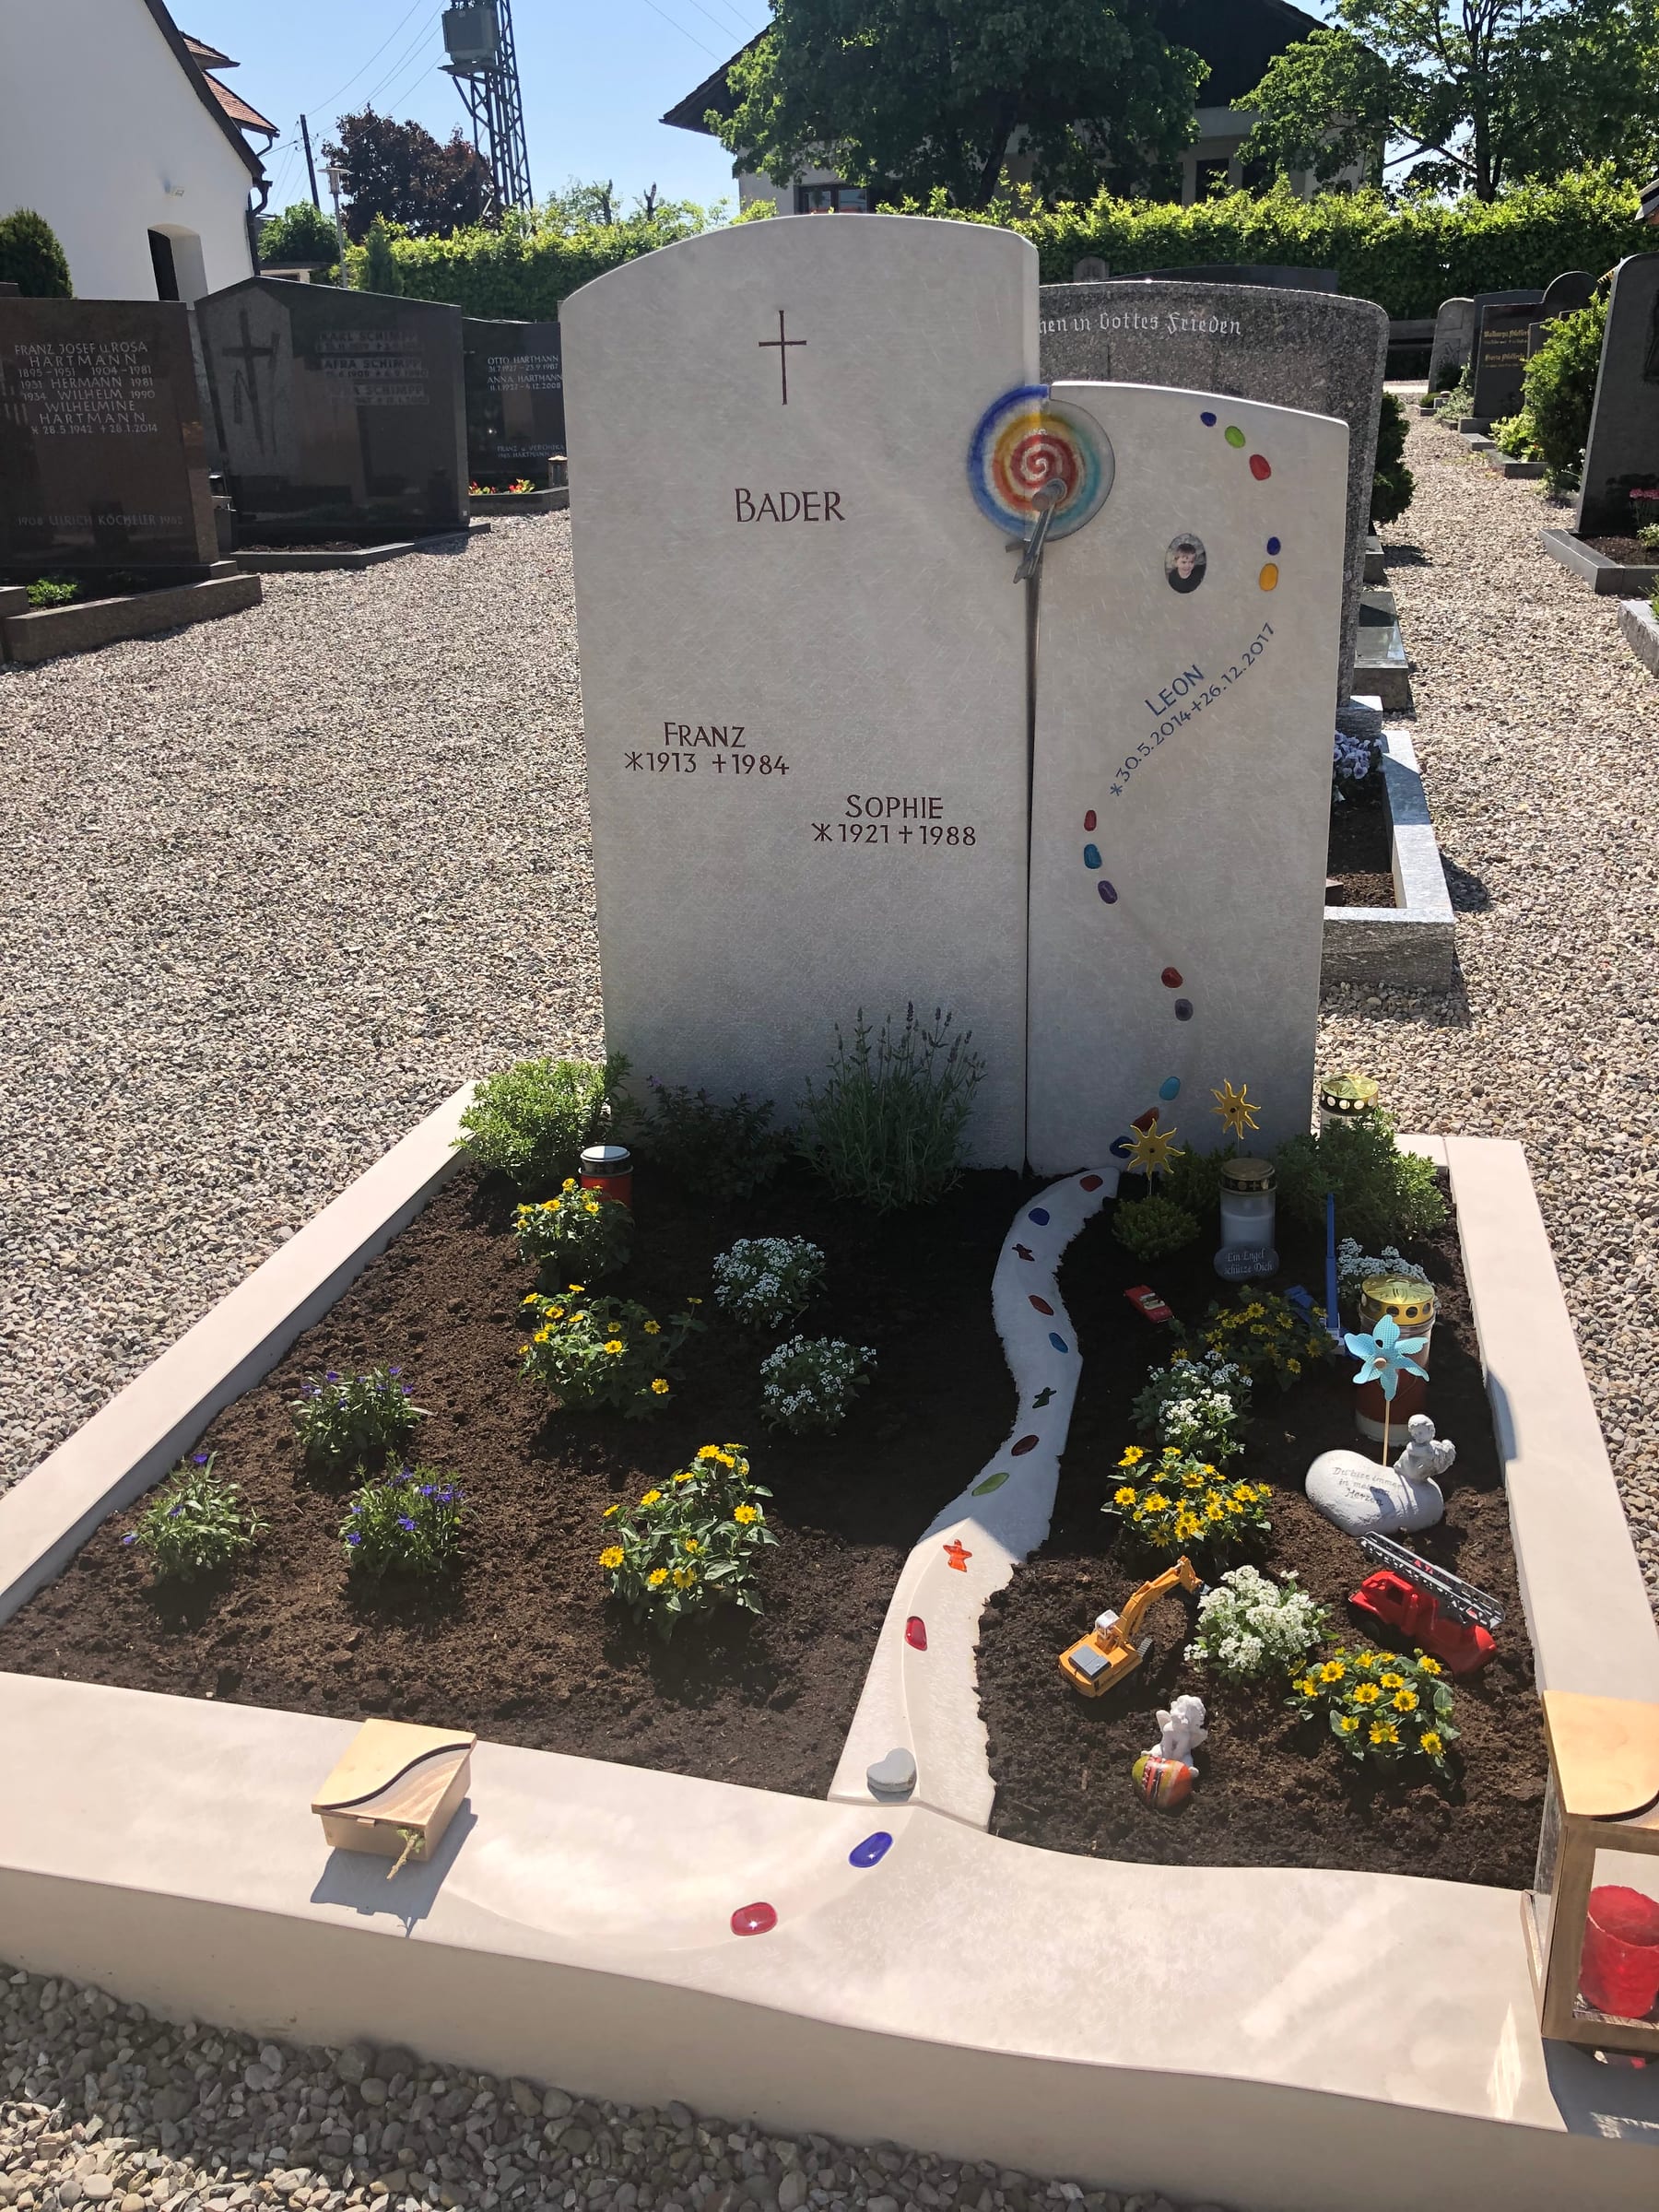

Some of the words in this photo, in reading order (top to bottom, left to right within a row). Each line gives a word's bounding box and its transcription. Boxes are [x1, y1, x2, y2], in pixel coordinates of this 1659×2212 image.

[1074, 318, 1091, 333] in
[1099, 312, 1159, 331] Gottes
[1166, 312, 1241, 335] Frieden
[15, 344, 54, 356] FRANZ
[59, 342, 97, 355] JOSEF
[29, 354, 137, 368] HARTMANN
[487, 357, 510, 366] OTTO
[512, 354, 559, 364] HARTMANN
[21, 379, 43, 389] 1931
[51, 376, 123, 389] HERMANN
[130, 377, 153, 387] 1981
[487, 375, 514, 384] ANNA
[517, 373, 562, 383] HARTMANN
[23, 392, 47, 402] 1934
[56, 388, 123, 401] WILHELM
[130, 389, 156, 399] 1990
[44, 400, 135, 413] WILHELMINE
[39, 412, 147, 426] HARTMANN
[735, 488, 845, 523] BADER
[49, 515, 92, 526] ULRICH
[1145, 664, 1205, 717] LEON
[663, 722, 747, 748] FRANZ
[844, 794, 944, 820] SOPHIE
[1227, 1253, 1241, 1262] Ein
[1241, 1247, 1265, 1263] Engel
[1253, 1260, 1274, 1273] Dich
[1338, 1477, 1348, 1486] in
[1371, 1475, 1404, 1488] immer
